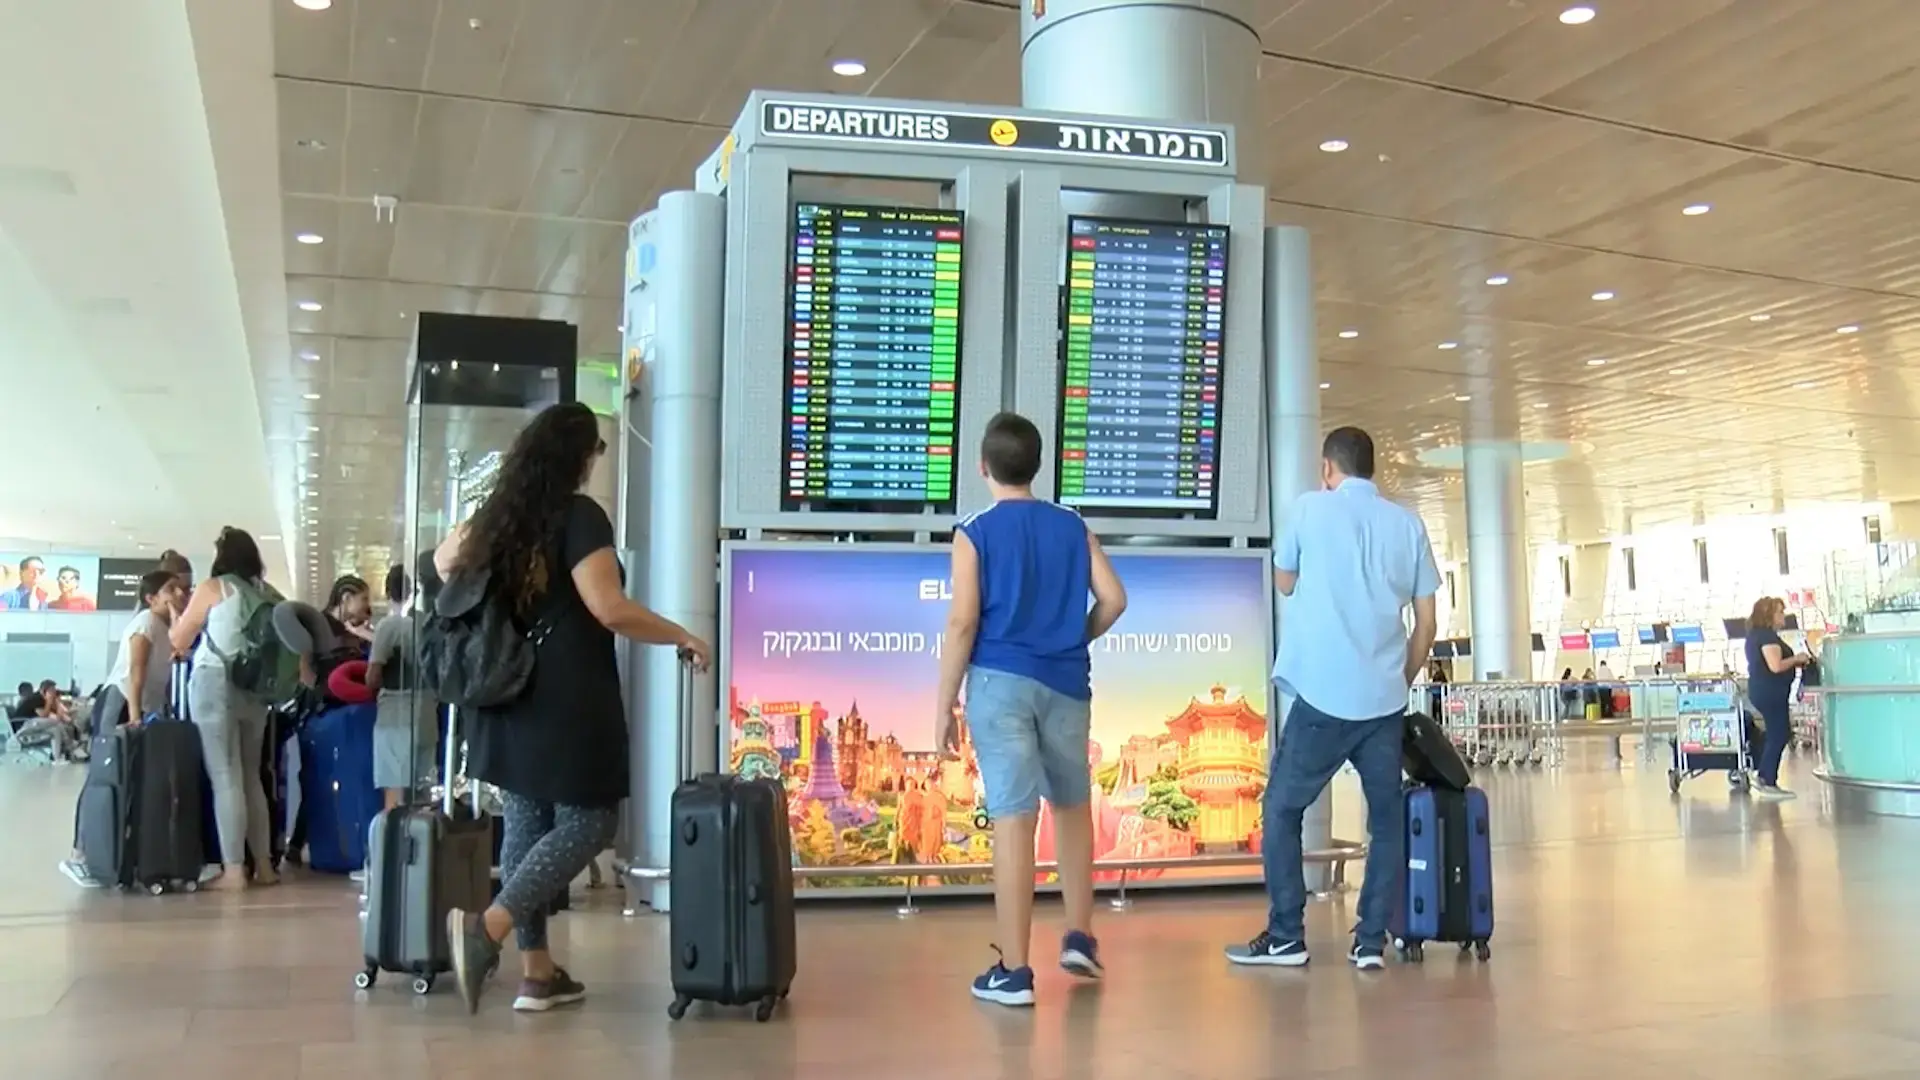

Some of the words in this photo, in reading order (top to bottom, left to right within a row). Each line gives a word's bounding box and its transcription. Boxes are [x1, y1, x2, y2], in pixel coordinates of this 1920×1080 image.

[773, 106, 949, 140] DEPARTURES
[1058, 125, 1213, 160] המראות
[763, 631, 841, 658] ובנגקוק
[848, 632, 925, 652] מומבאי
[1103, 633, 1168, 653] ישירות
[1174, 633, 1232, 653] טיסות
